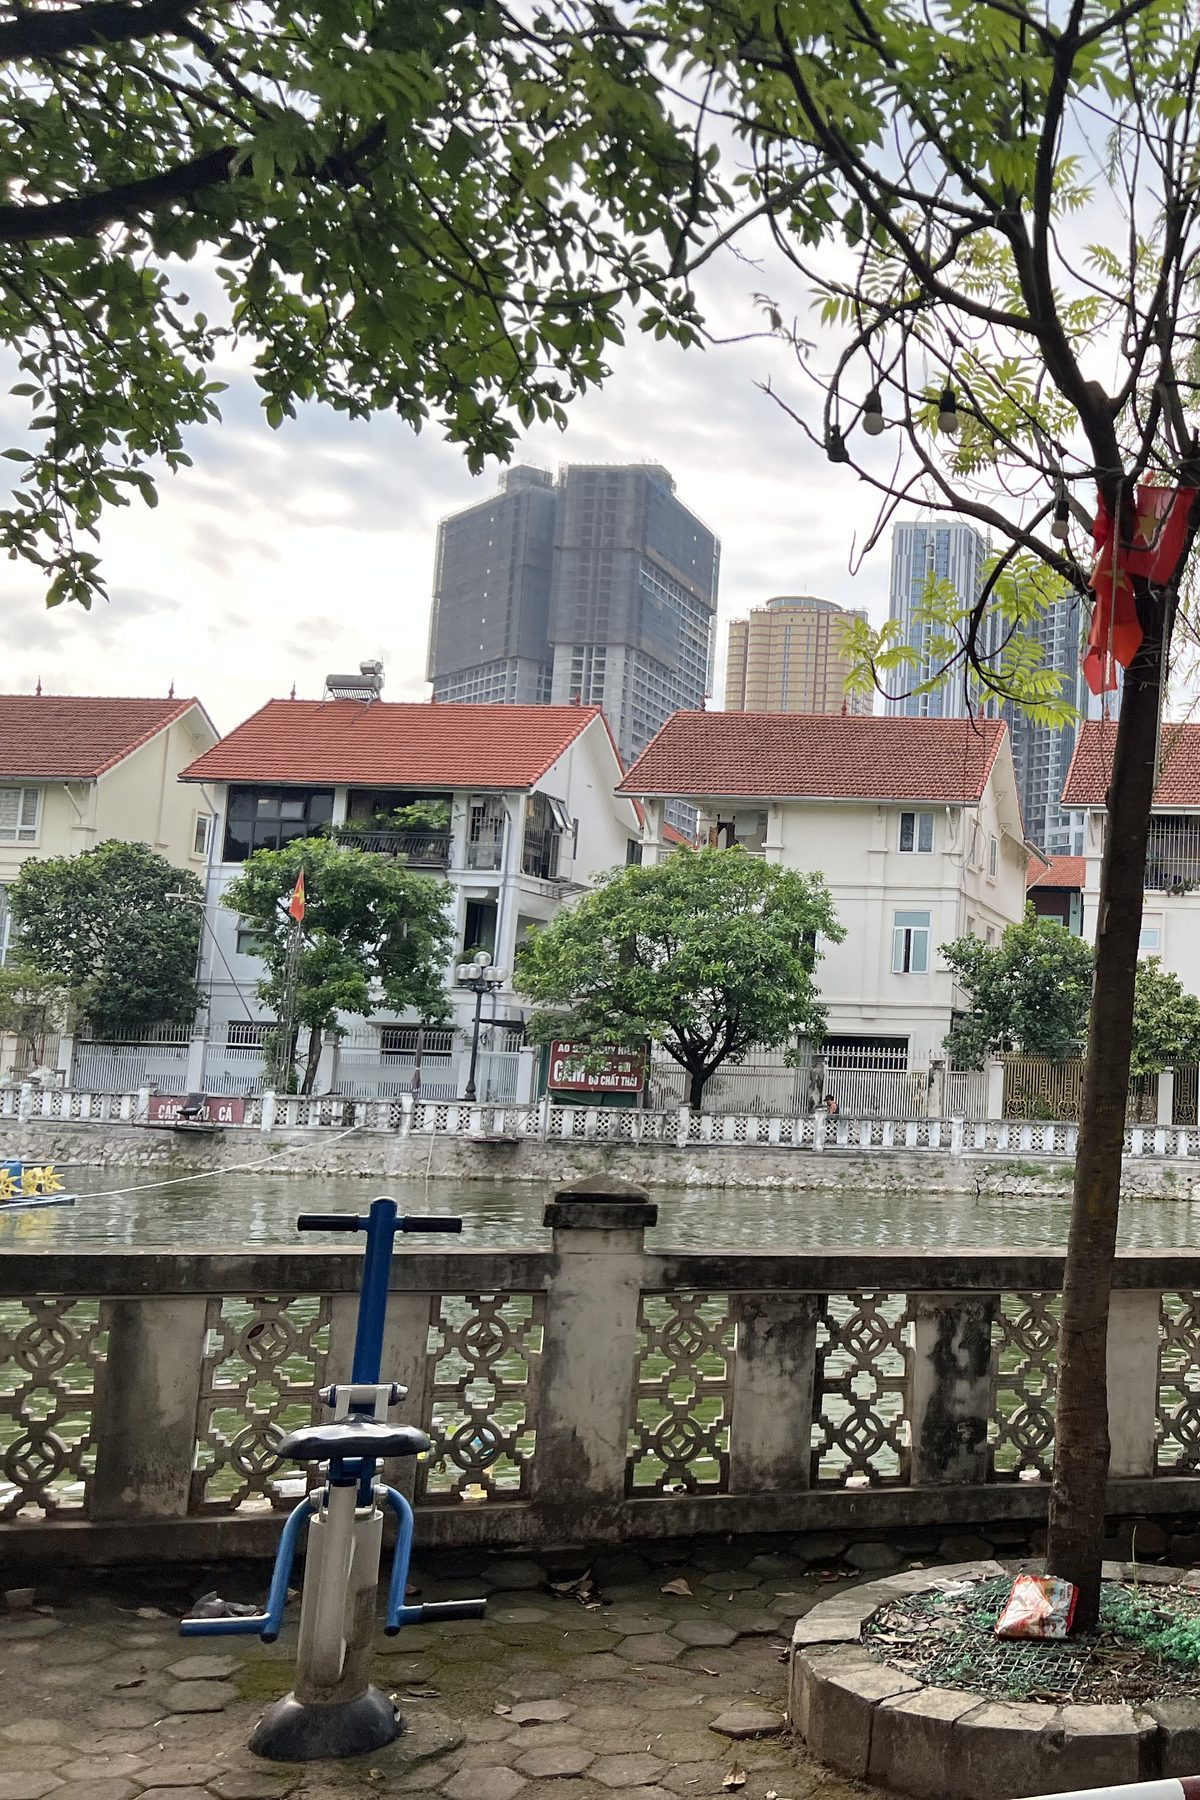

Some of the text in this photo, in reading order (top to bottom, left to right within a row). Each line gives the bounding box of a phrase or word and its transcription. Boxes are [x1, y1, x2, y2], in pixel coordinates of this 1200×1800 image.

[557, 1043, 570, 1053] AO
[600, 1073, 619, 1086] CHẤT
[218, 1102, 233, 1121] CÁ
